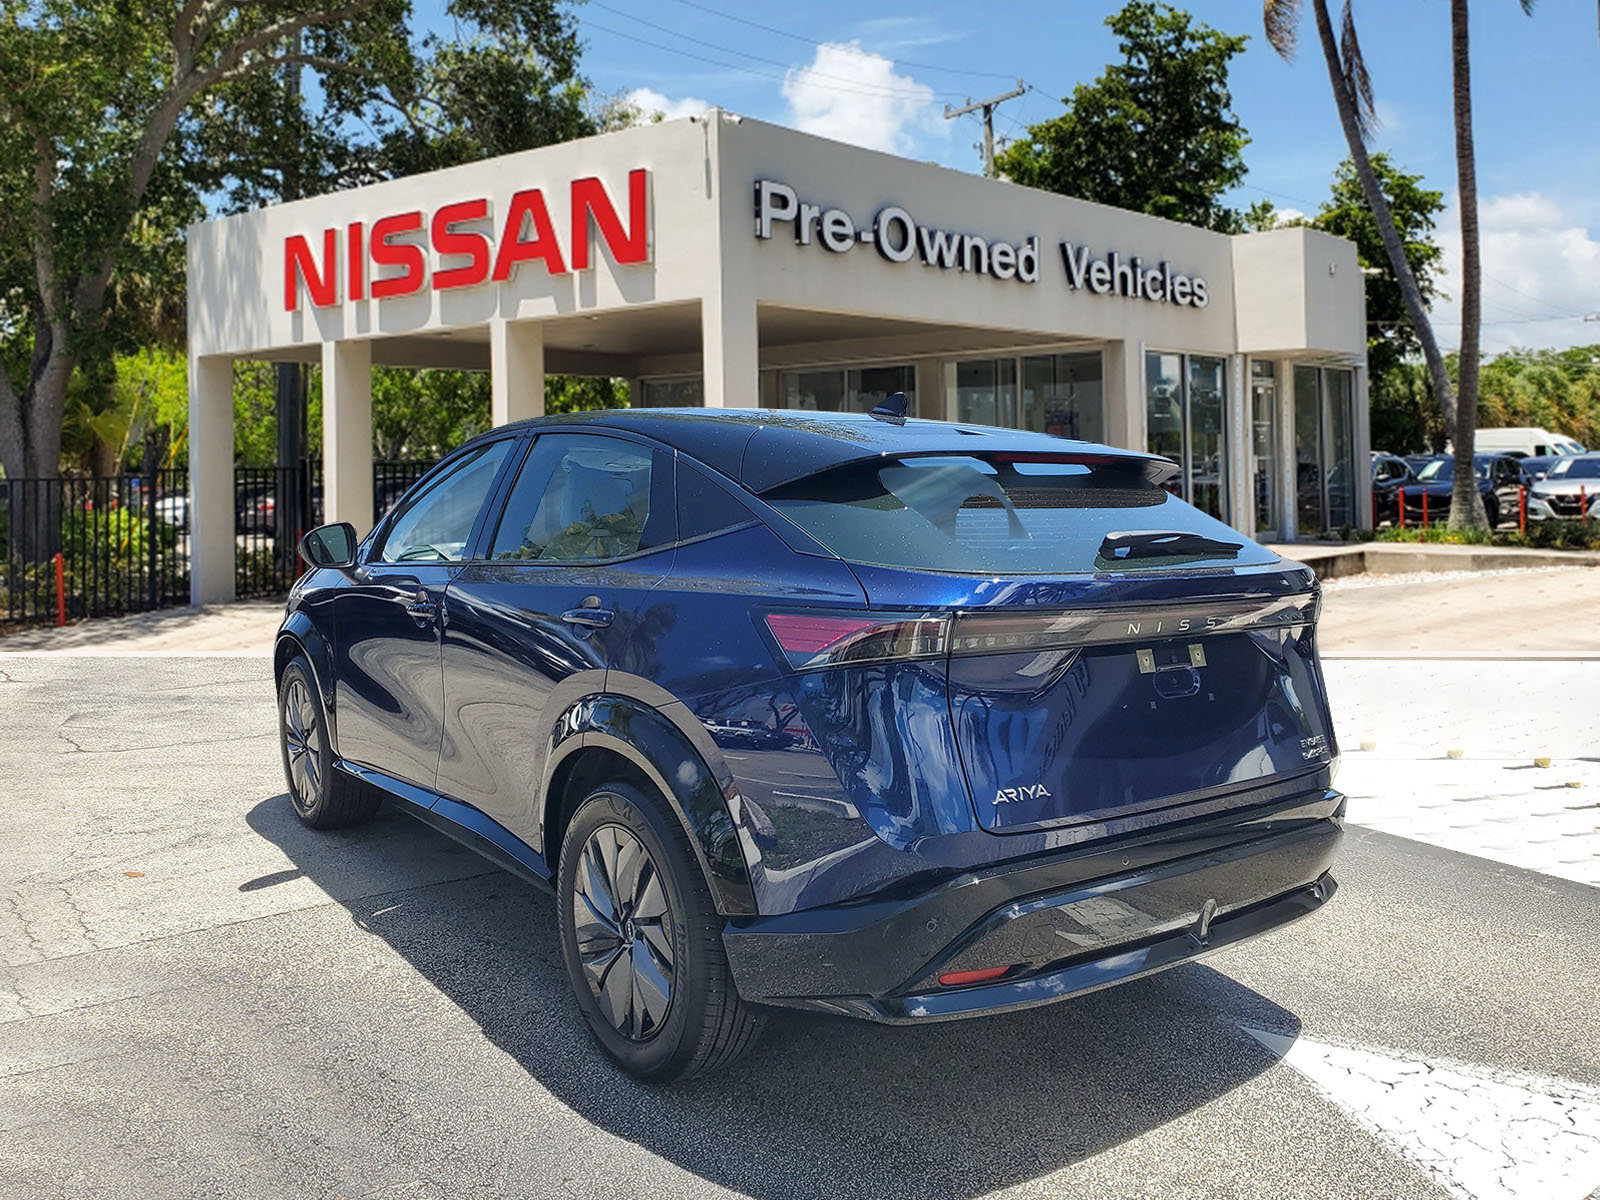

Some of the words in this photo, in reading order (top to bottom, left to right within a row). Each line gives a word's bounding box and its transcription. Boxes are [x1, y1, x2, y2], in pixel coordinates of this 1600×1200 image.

[284, 168, 648, 312] NISSAN
[754, 178, 1040, 283] Pre-Owned
[1059, 242, 1209, 308] Vehicles
[991, 783, 1052, 805] ARIYA
